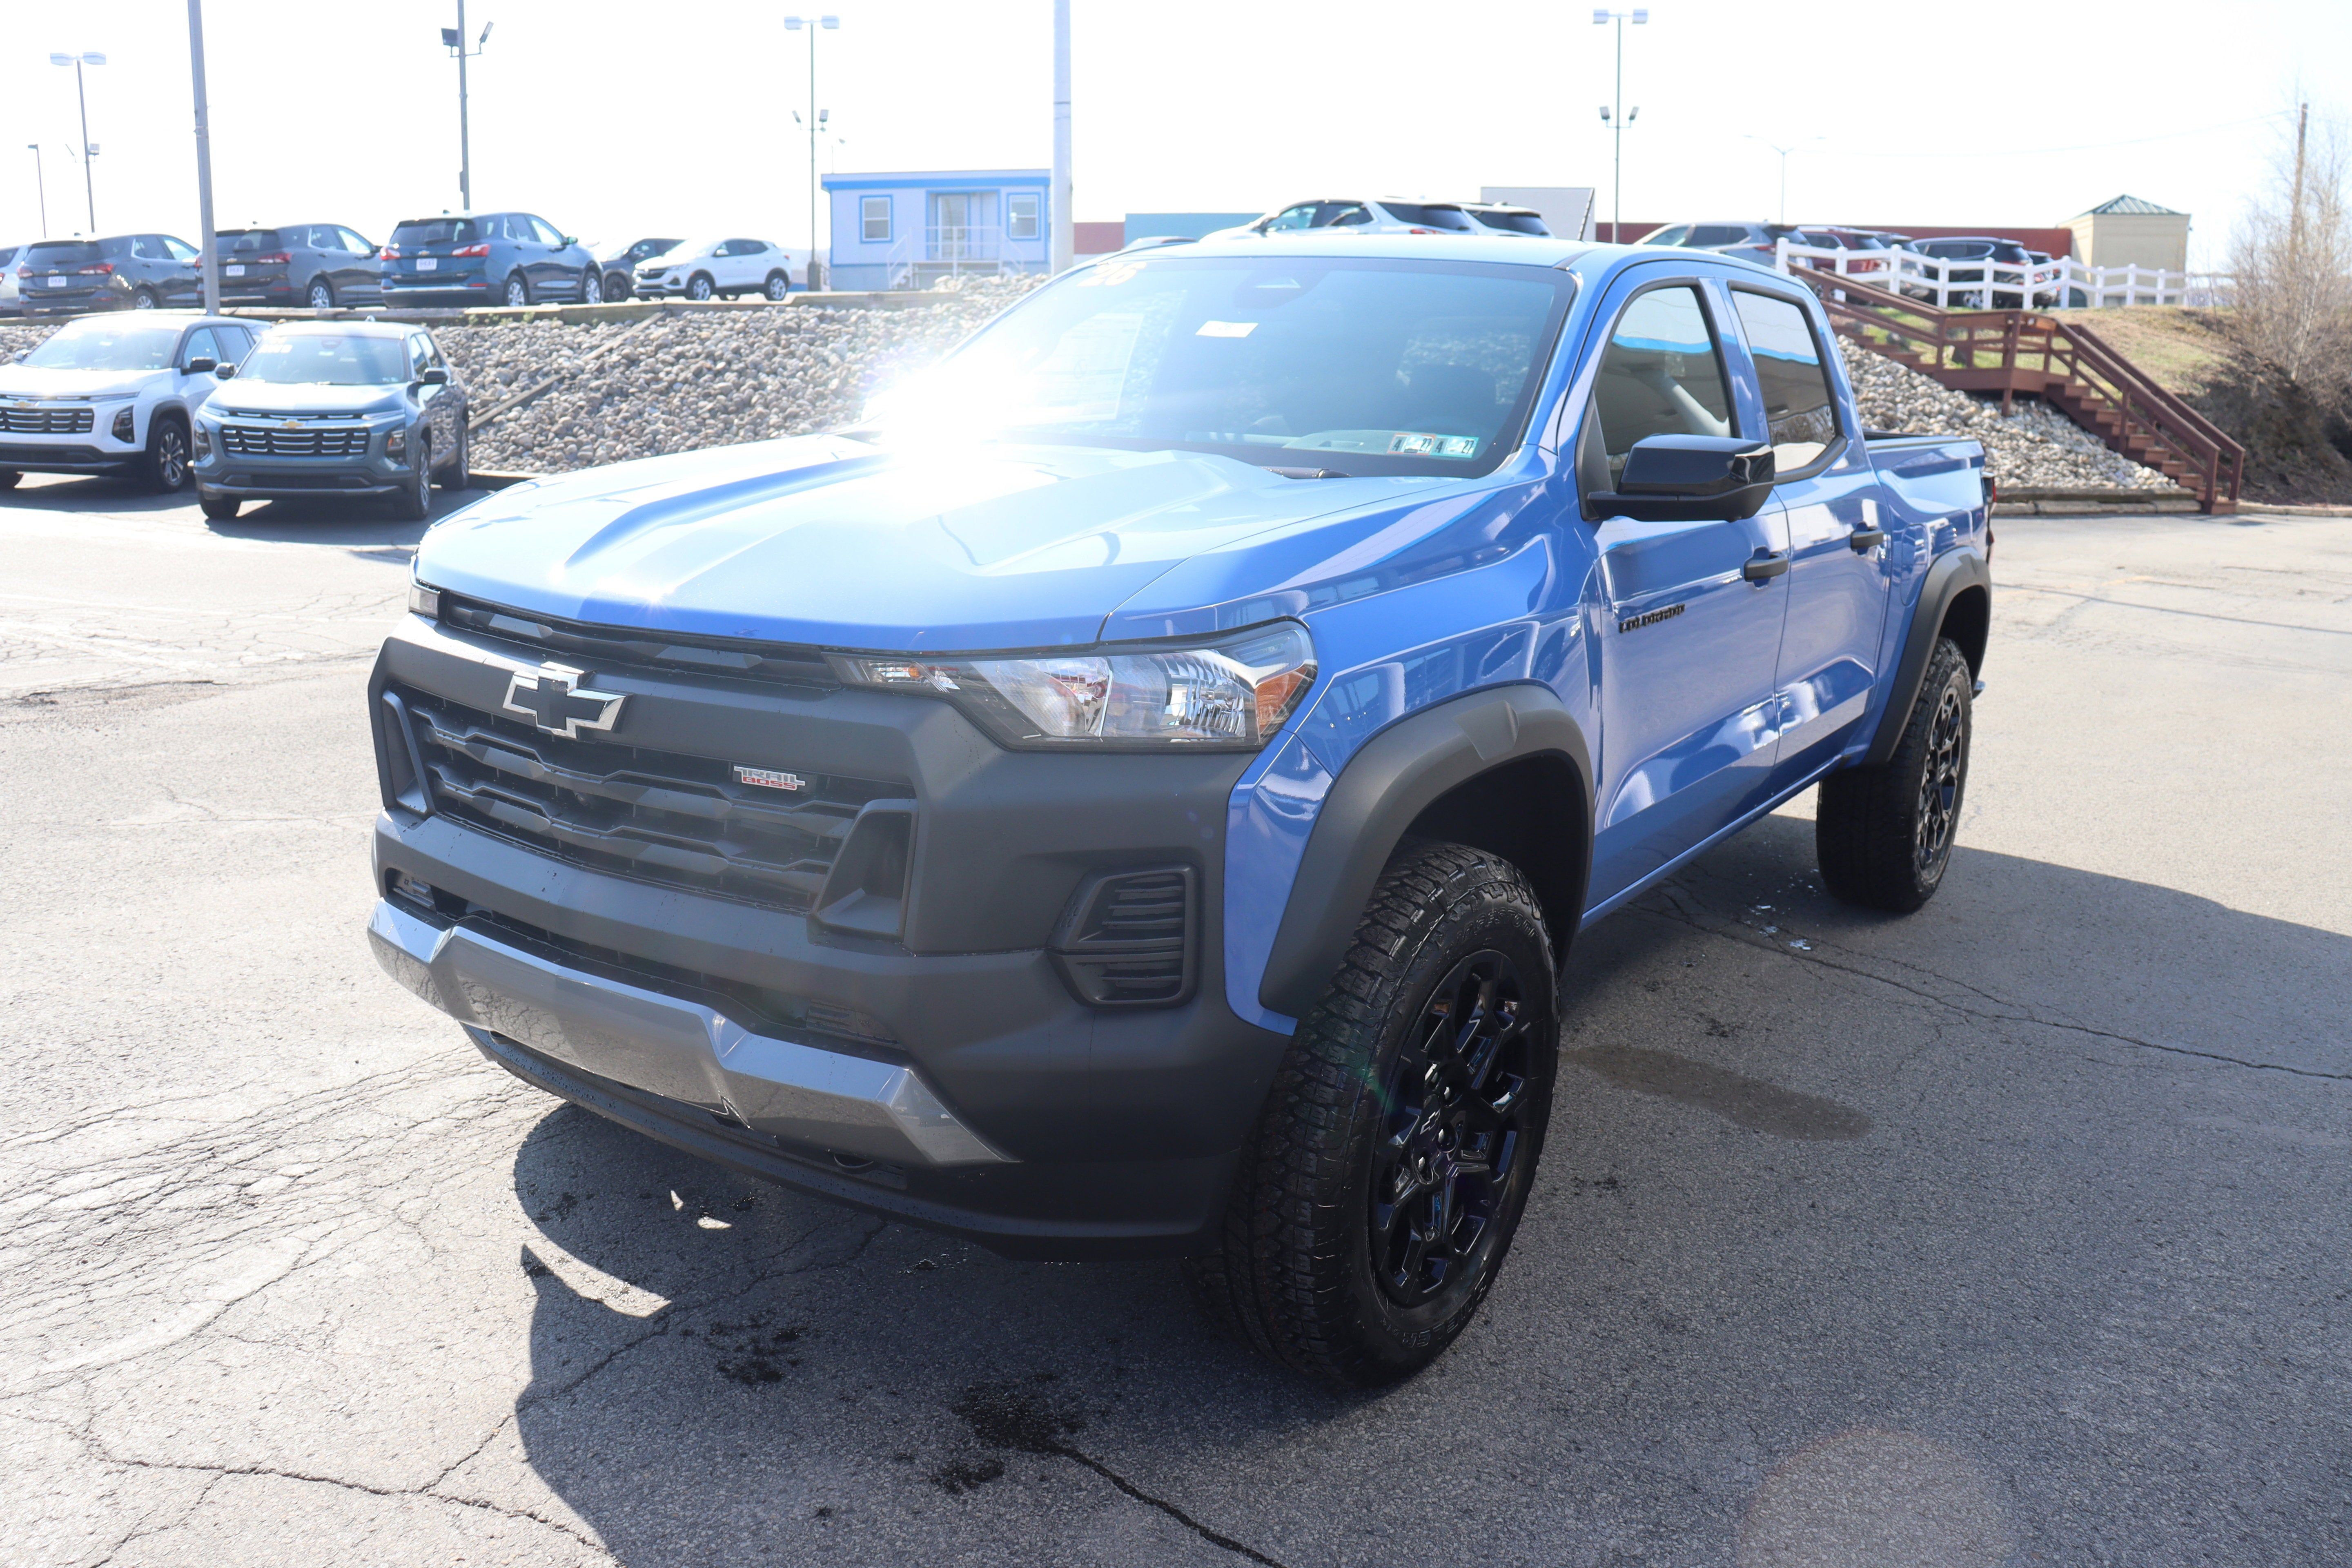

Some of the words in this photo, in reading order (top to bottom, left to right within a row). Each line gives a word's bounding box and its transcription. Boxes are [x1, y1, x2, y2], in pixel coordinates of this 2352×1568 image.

[1461, 439, 1474, 454] 27
[734, 766, 806, 786] TRAIL
[743, 776, 796, 790] BOSS
